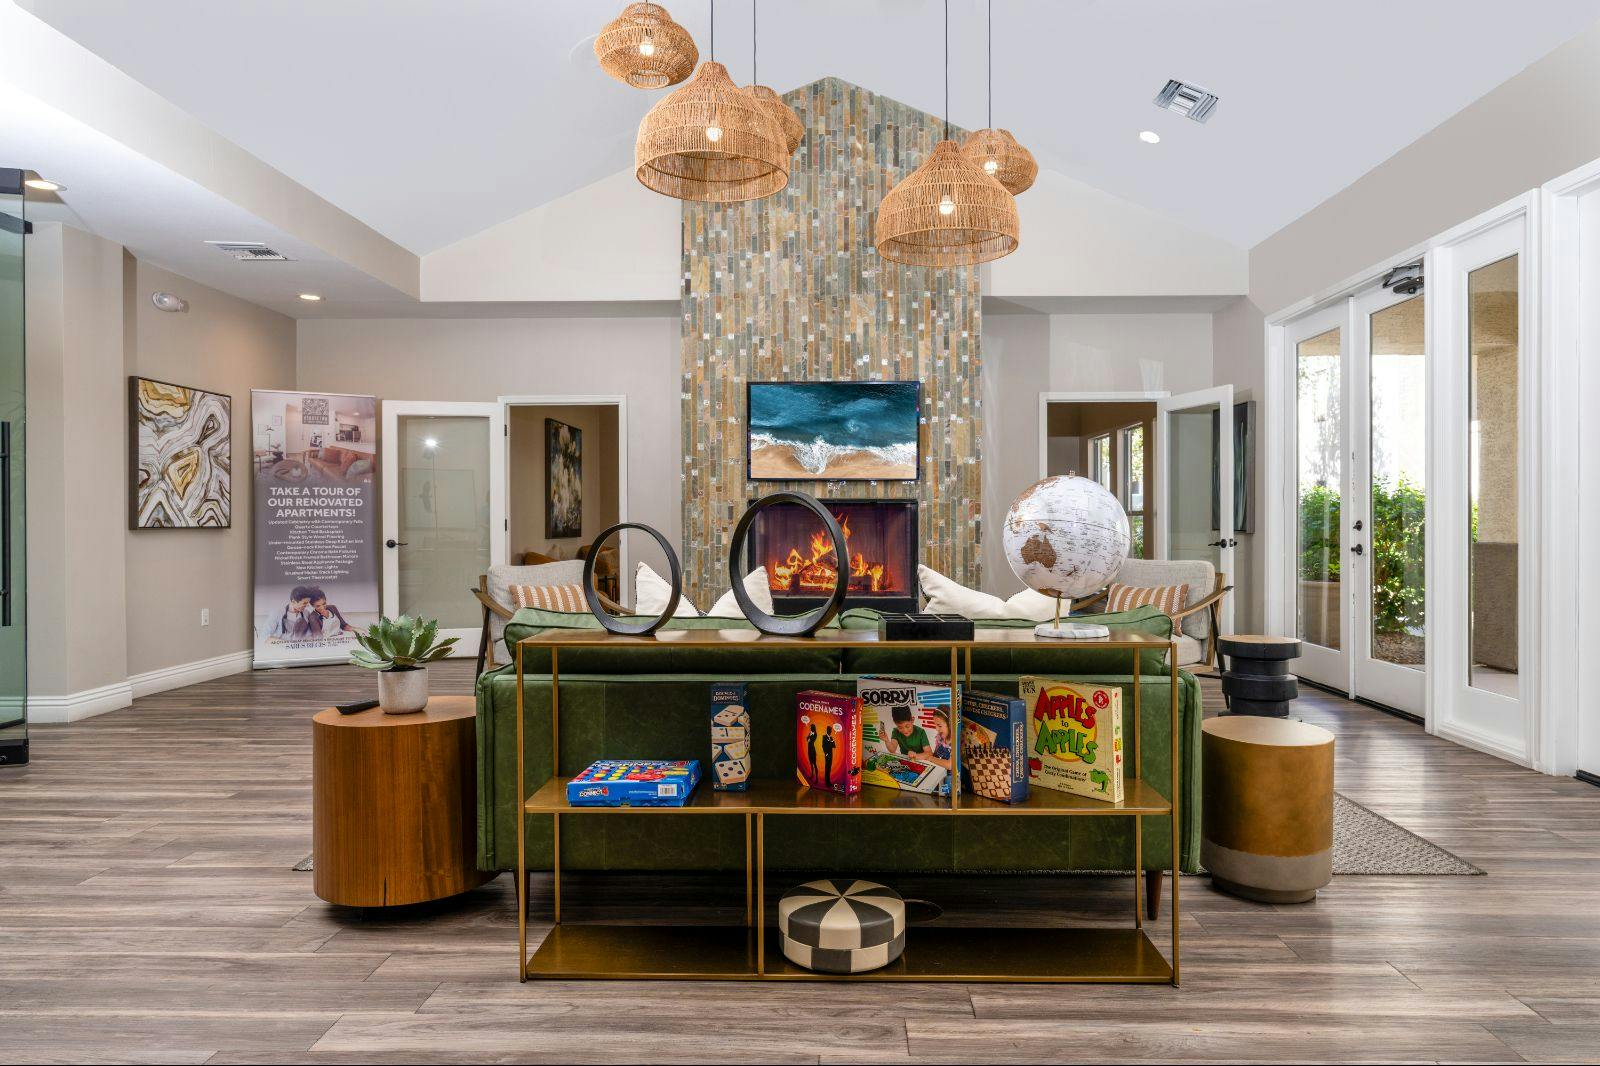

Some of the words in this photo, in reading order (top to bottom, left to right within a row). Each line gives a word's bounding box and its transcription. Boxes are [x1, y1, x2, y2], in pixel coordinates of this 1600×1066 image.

[346, 487, 361, 496] OF
[268, 498, 293, 506] OUR
[296, 498, 363, 506] RENOVATED
[276, 509, 355, 517] APARTMENTS!
[860, 687, 918, 707] SORRY!
[800, 702, 843, 716] CODENAMES
[1034, 687, 1096, 729] APPLES
[1035, 721, 1098, 764] APPLES
